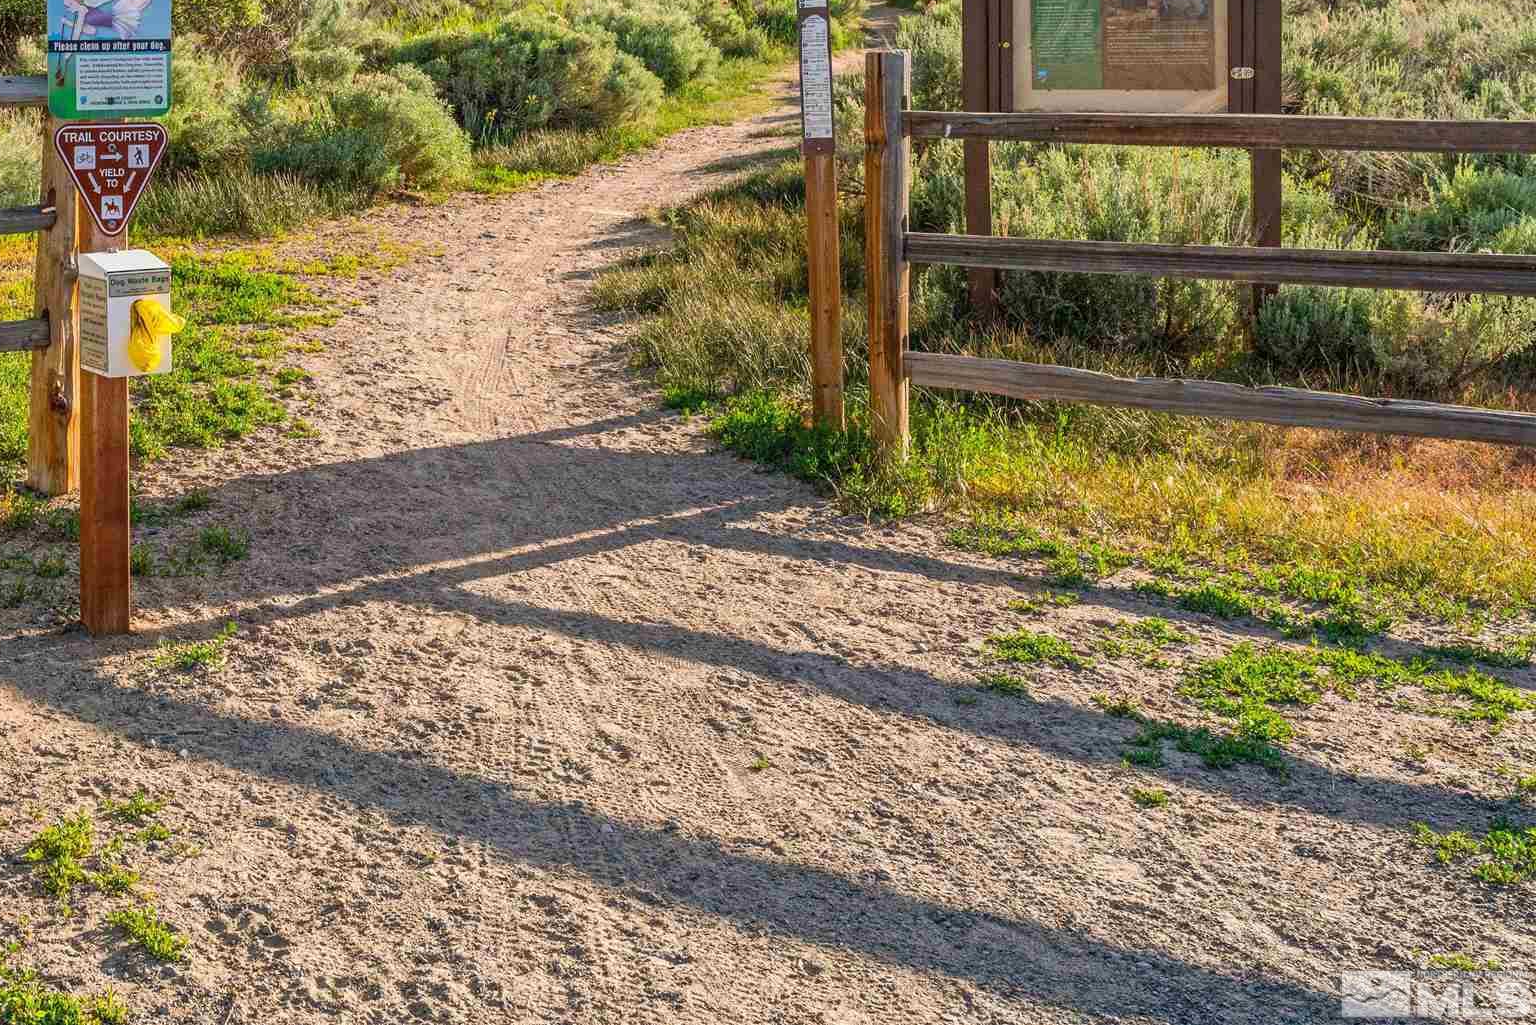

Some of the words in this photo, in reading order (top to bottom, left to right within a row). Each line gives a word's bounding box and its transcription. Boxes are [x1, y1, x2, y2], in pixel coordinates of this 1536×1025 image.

[54, 41, 78, 52] Please
[79, 41, 100, 51] clean
[101, 42, 111, 51] up
[112, 41, 130, 51] after
[132, 41, 148, 51] your
[63, 131, 95, 144] TRAIL
[99, 130, 161, 143] COURTESY
[99, 167, 125, 178] YIELD
[106, 178, 118, 188] TO
